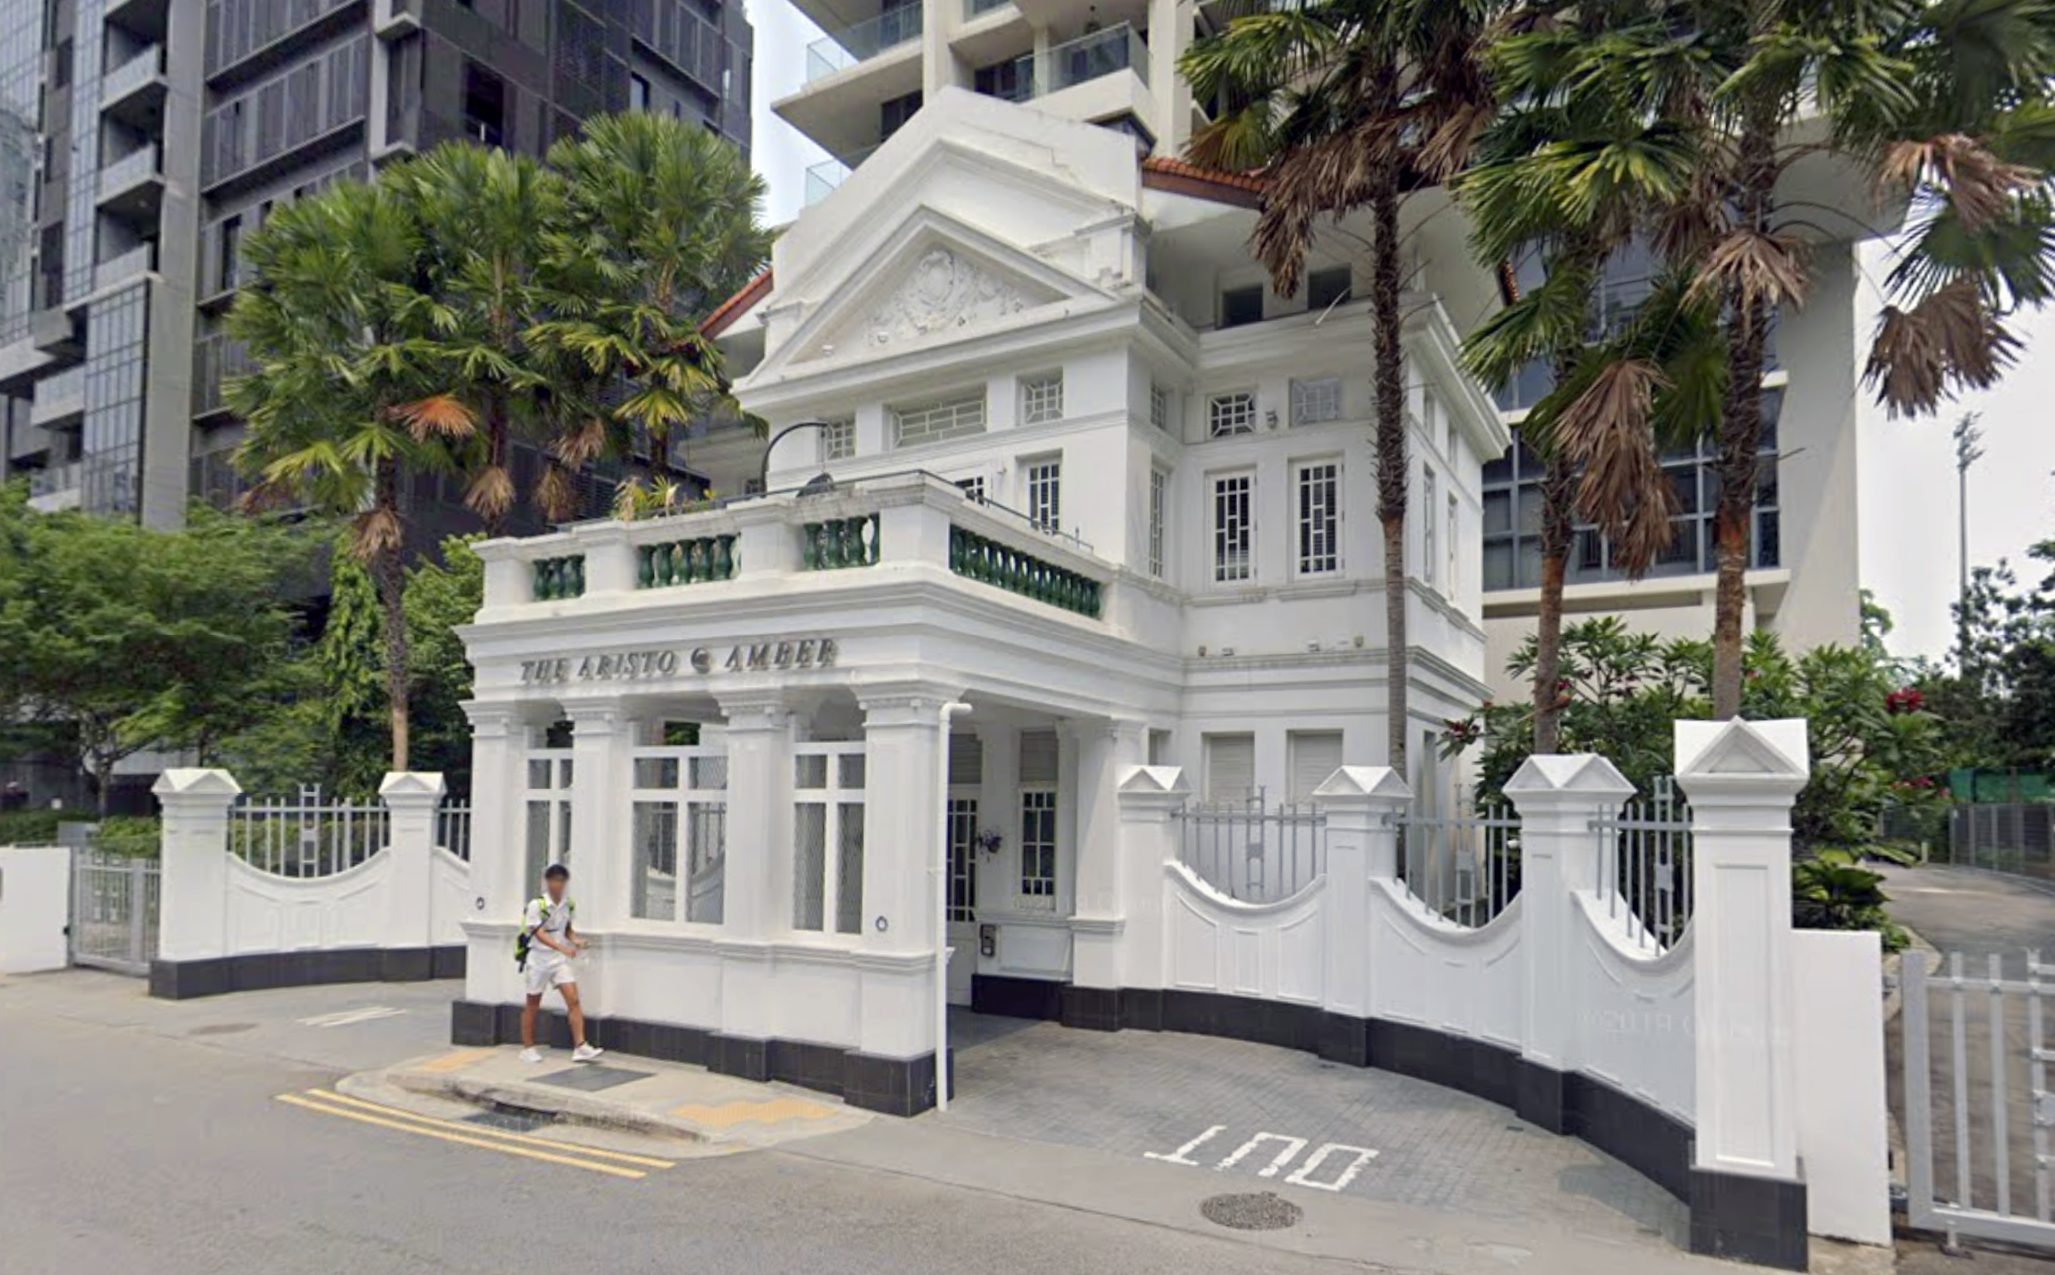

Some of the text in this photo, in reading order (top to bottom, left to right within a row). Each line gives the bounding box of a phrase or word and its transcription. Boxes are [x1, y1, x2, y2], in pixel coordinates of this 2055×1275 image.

[520, 658, 569, 682] THE
[577, 650, 679, 680] ARISTO
[725, 638, 838, 672] AMBER
[1143, 1125, 1379, 1191] OUT
